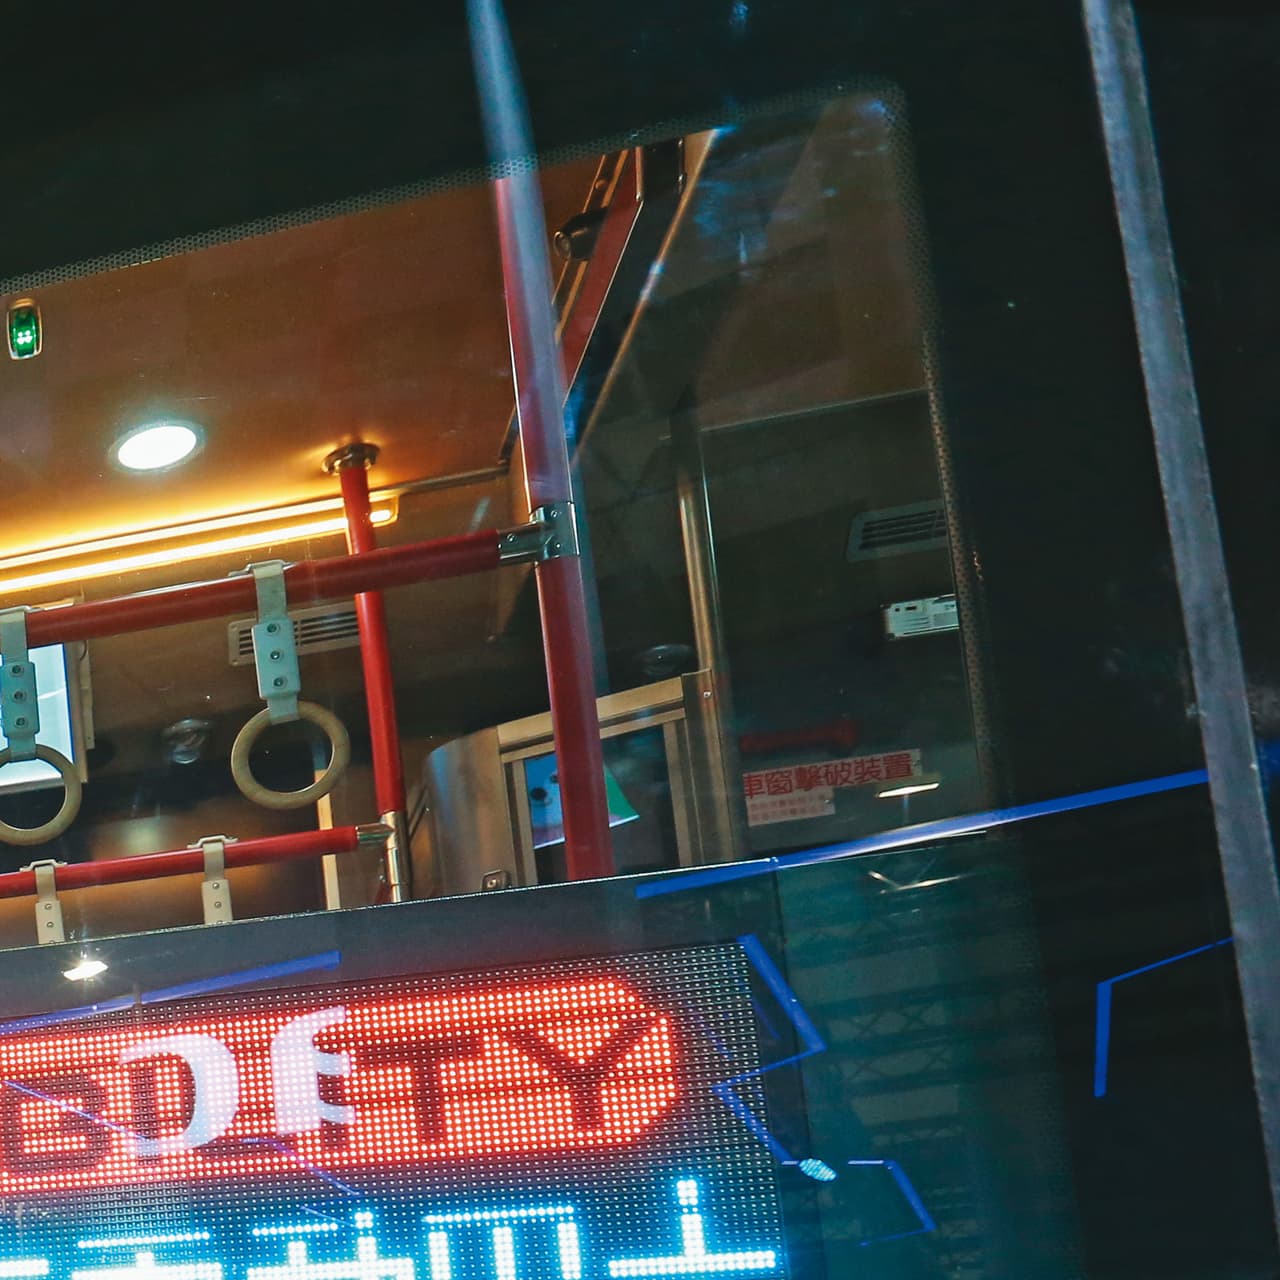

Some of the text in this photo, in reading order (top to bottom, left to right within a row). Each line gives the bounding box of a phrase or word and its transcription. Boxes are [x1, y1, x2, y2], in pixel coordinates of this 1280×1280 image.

[744, 753, 913, 798] 車窗擊破裝置
